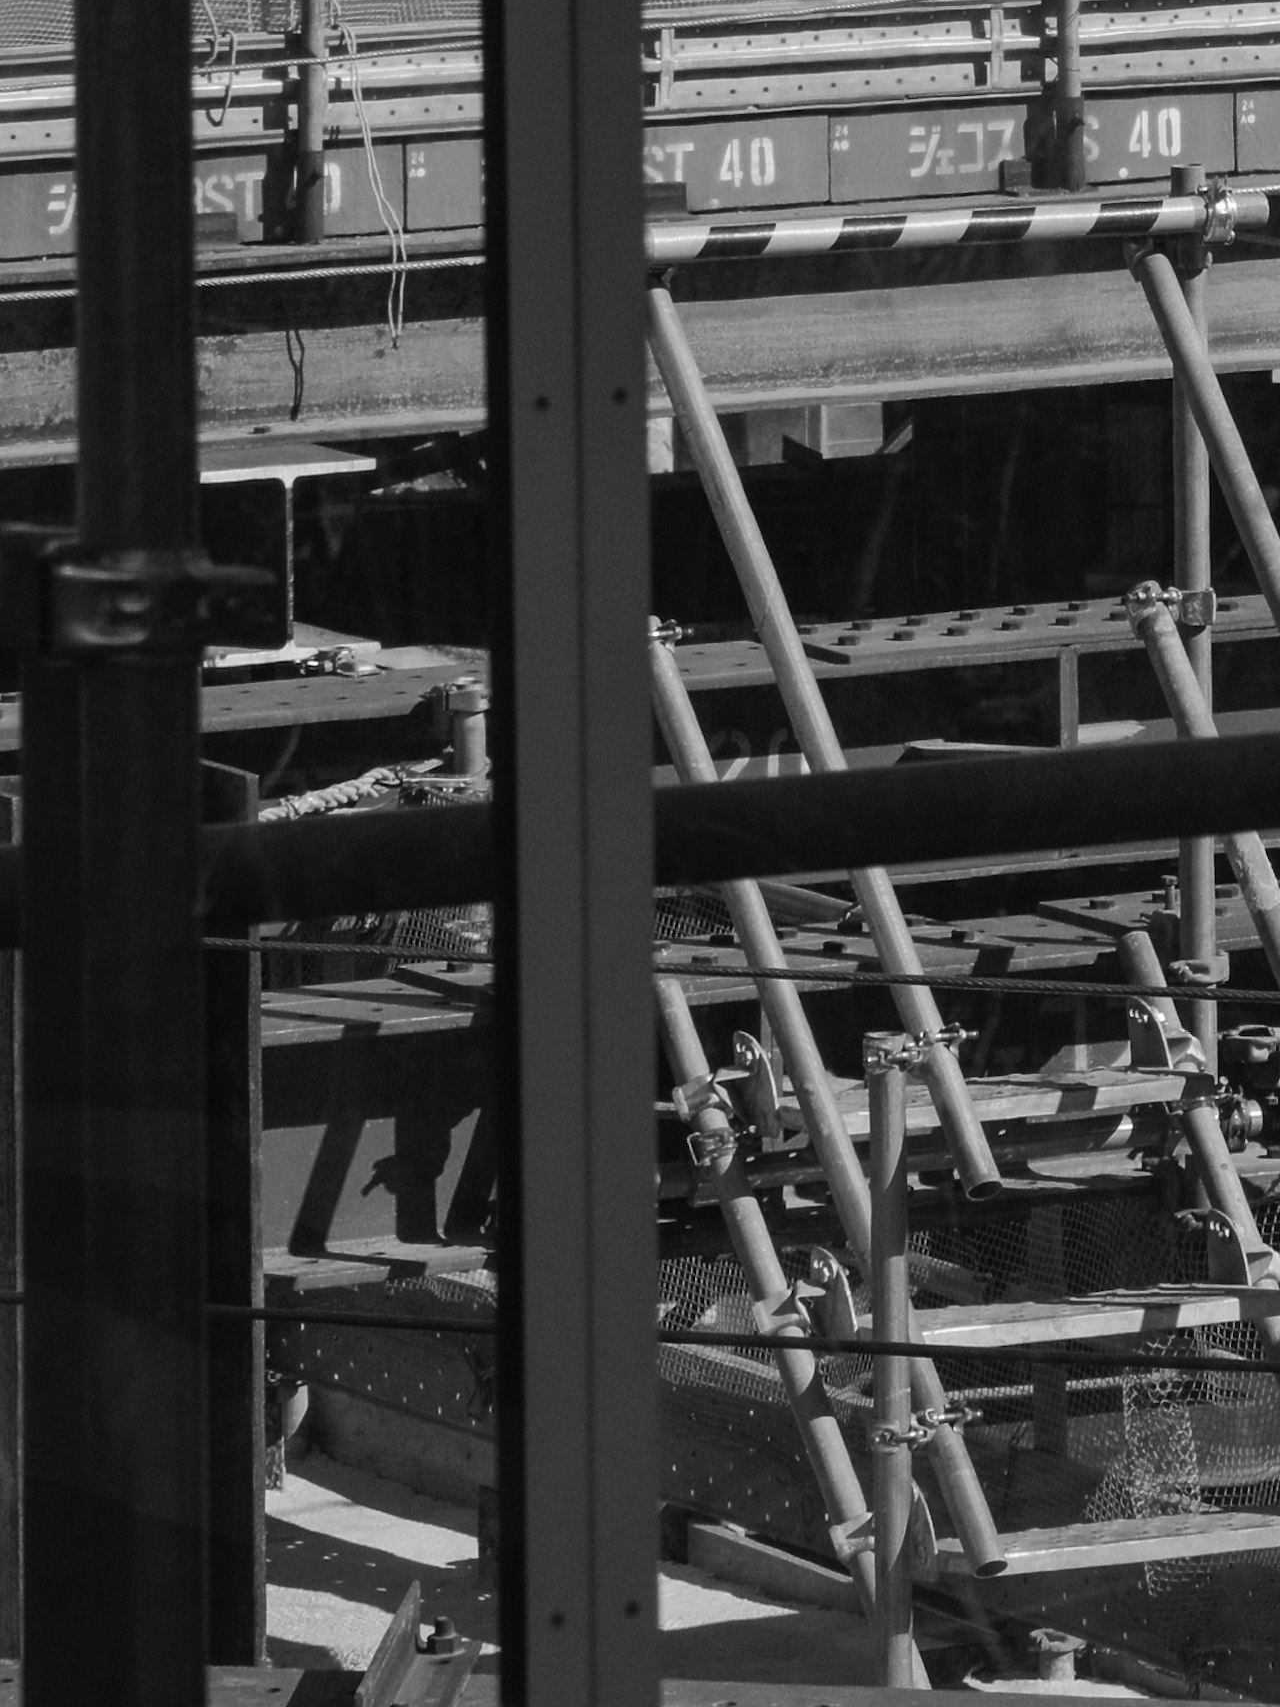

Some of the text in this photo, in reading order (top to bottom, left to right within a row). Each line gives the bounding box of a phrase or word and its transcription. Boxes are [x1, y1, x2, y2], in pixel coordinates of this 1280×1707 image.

[1241, 99, 1255, 112] 24
[834, 124, 849, 138] 24
[1128, 107, 1182, 158] 40
[410, 151, 425, 166] 24
[718, 136, 776, 187] 40
[909, 119, 1016, 178] ジェコス
